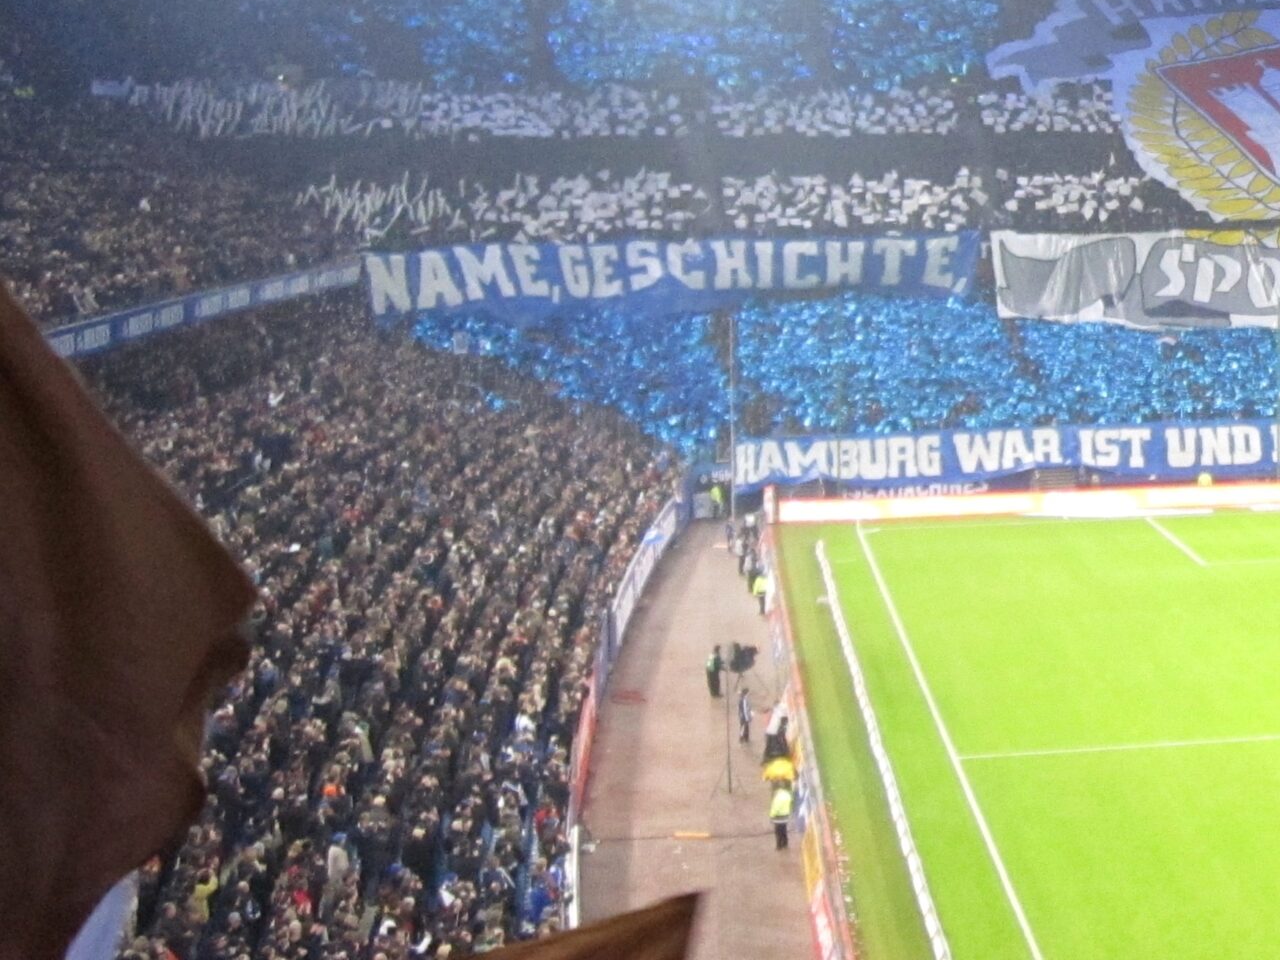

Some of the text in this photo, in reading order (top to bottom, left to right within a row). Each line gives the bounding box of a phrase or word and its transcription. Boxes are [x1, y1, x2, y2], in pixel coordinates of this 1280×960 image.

[735, 436, 942, 486] HAMBURG
[1079, 427, 1151, 468] IST
[1165, 424, 1262, 468] UND
